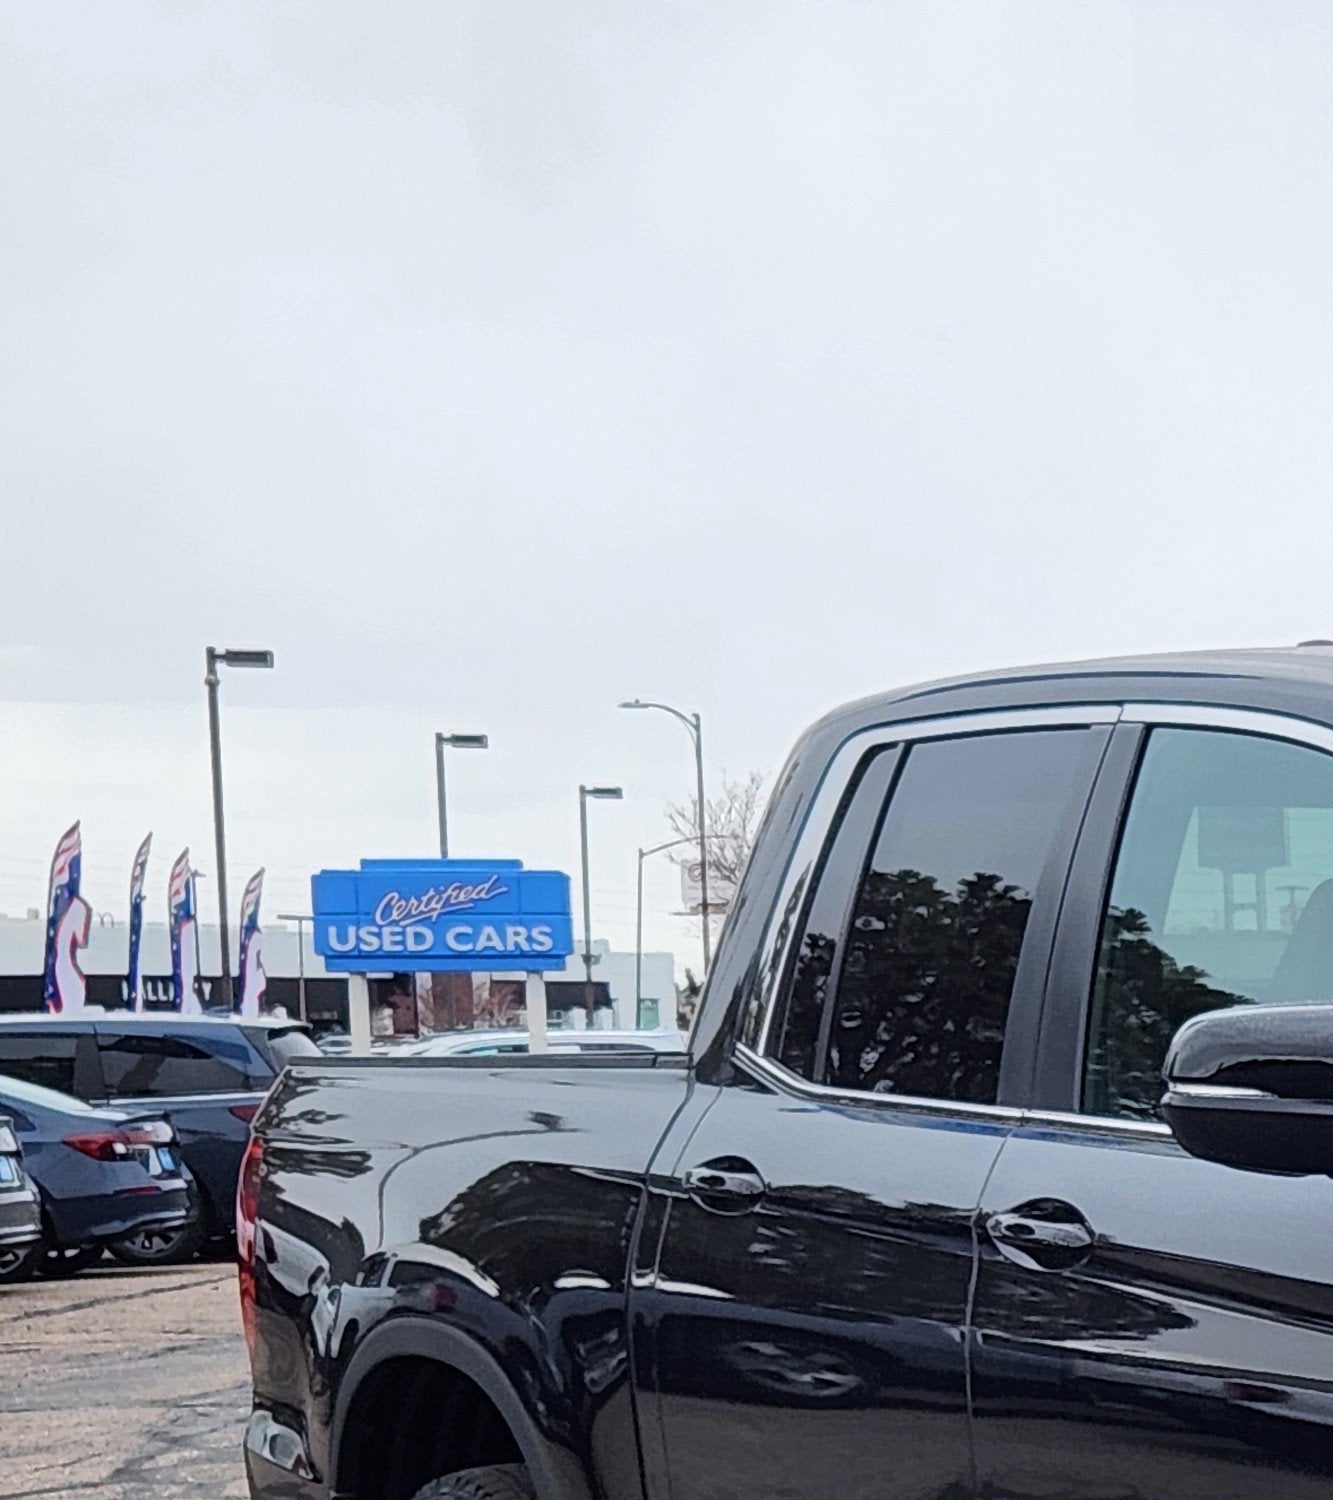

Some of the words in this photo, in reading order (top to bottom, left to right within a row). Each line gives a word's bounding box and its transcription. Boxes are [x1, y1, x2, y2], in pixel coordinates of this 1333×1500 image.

[373, 874, 509, 926] Certified
[327, 924, 436, 953] USED
[445, 924, 555, 953] CARS
